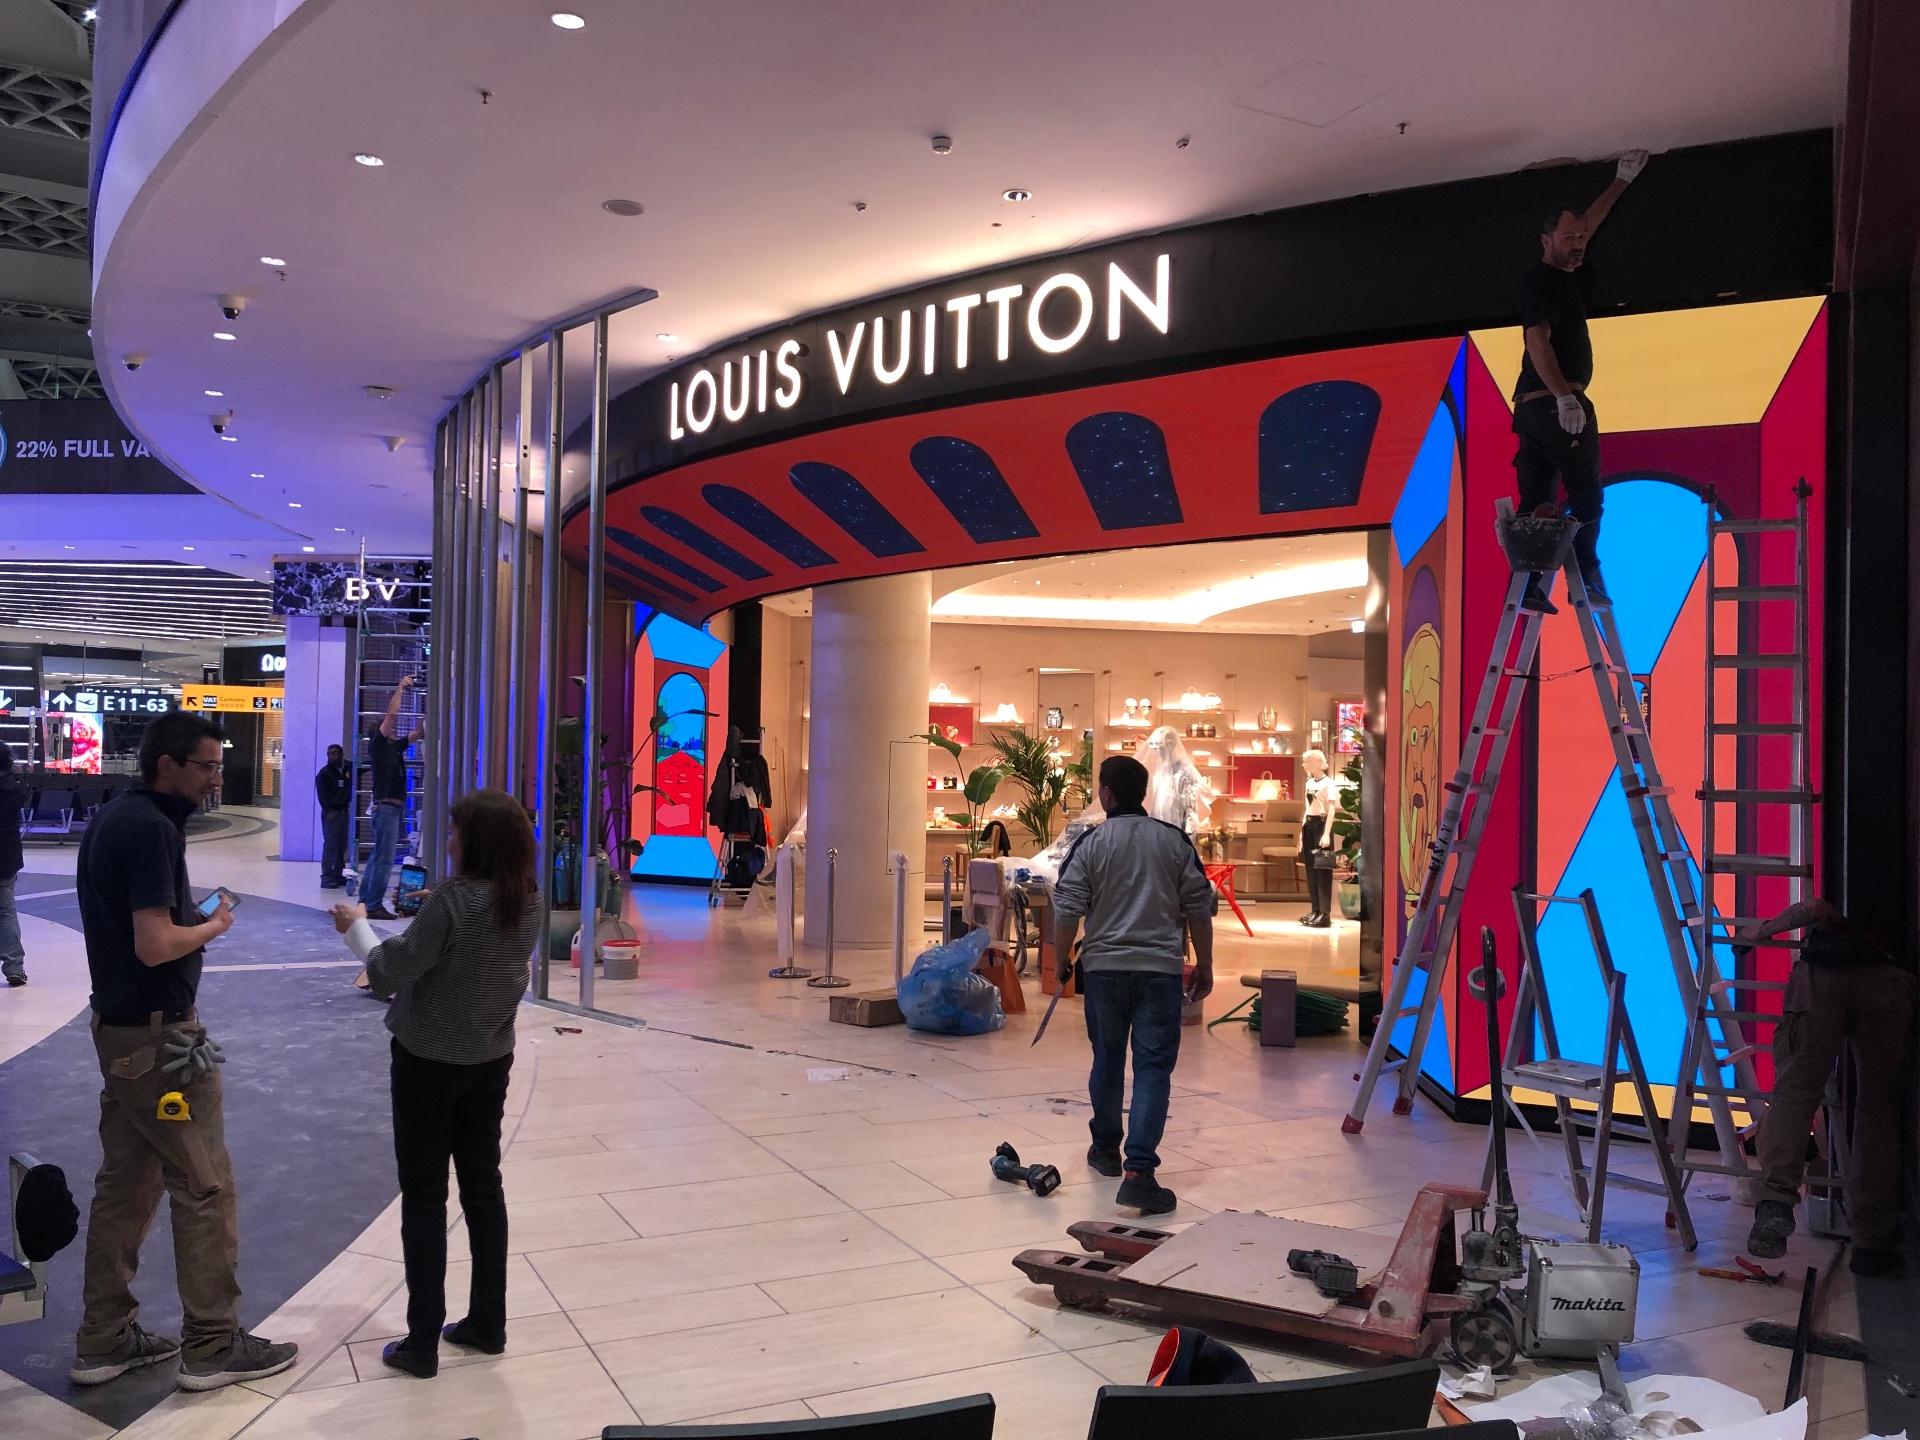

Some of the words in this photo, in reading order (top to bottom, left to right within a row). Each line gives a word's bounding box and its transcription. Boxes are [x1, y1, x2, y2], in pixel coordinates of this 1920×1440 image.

[670, 338, 803, 440] LOUIS
[828, 253, 1171, 396] VUITTON
[16, 439, 57, 459] 22%
[64, 439, 114, 458] FULL
